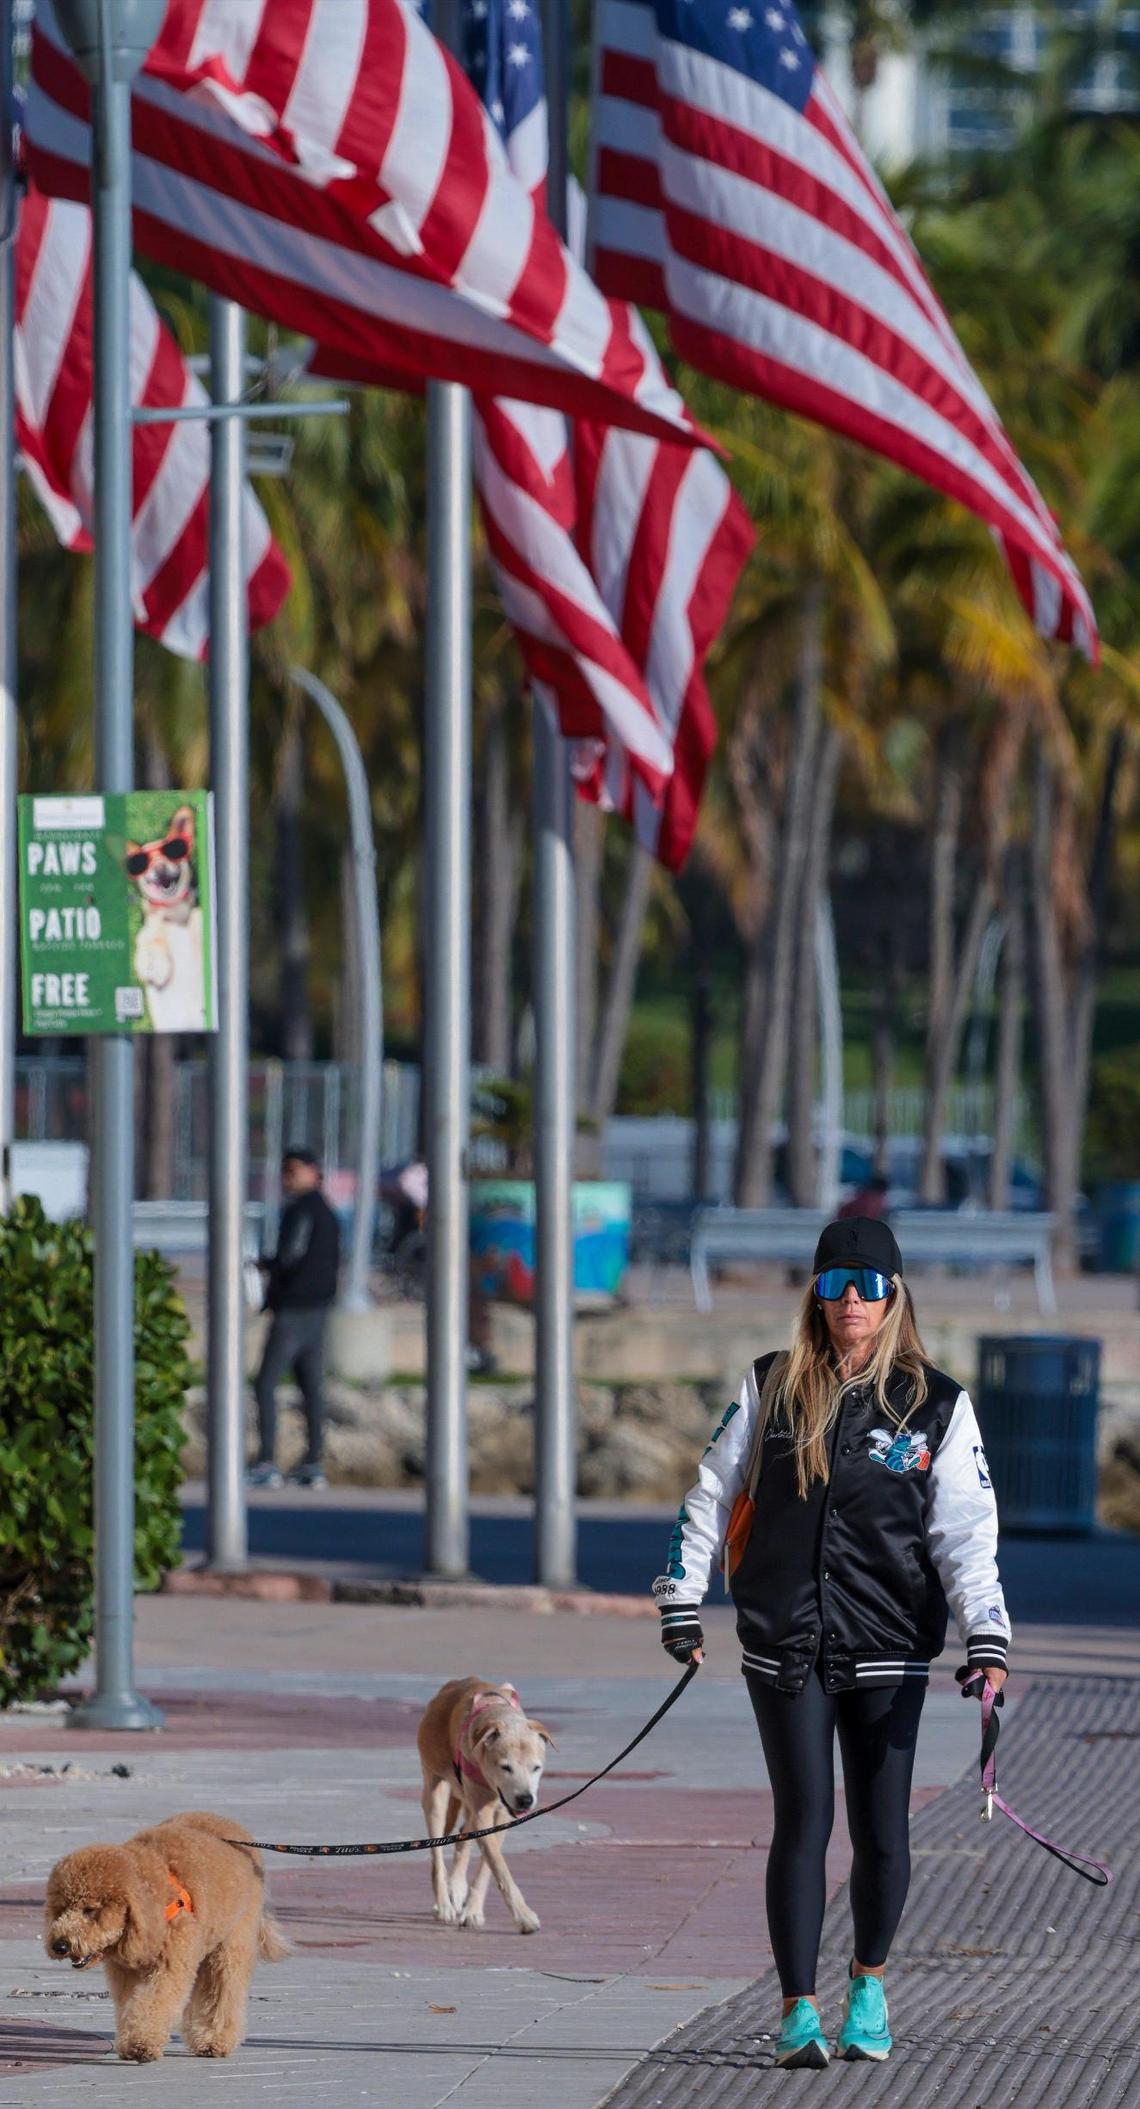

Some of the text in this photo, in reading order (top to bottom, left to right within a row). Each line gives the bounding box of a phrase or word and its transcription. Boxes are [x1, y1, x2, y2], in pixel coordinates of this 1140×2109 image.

[28, 843, 97, 876] PAWS
[29, 908, 101, 941] PATIO
[31, 973, 90, 1007] FREE
